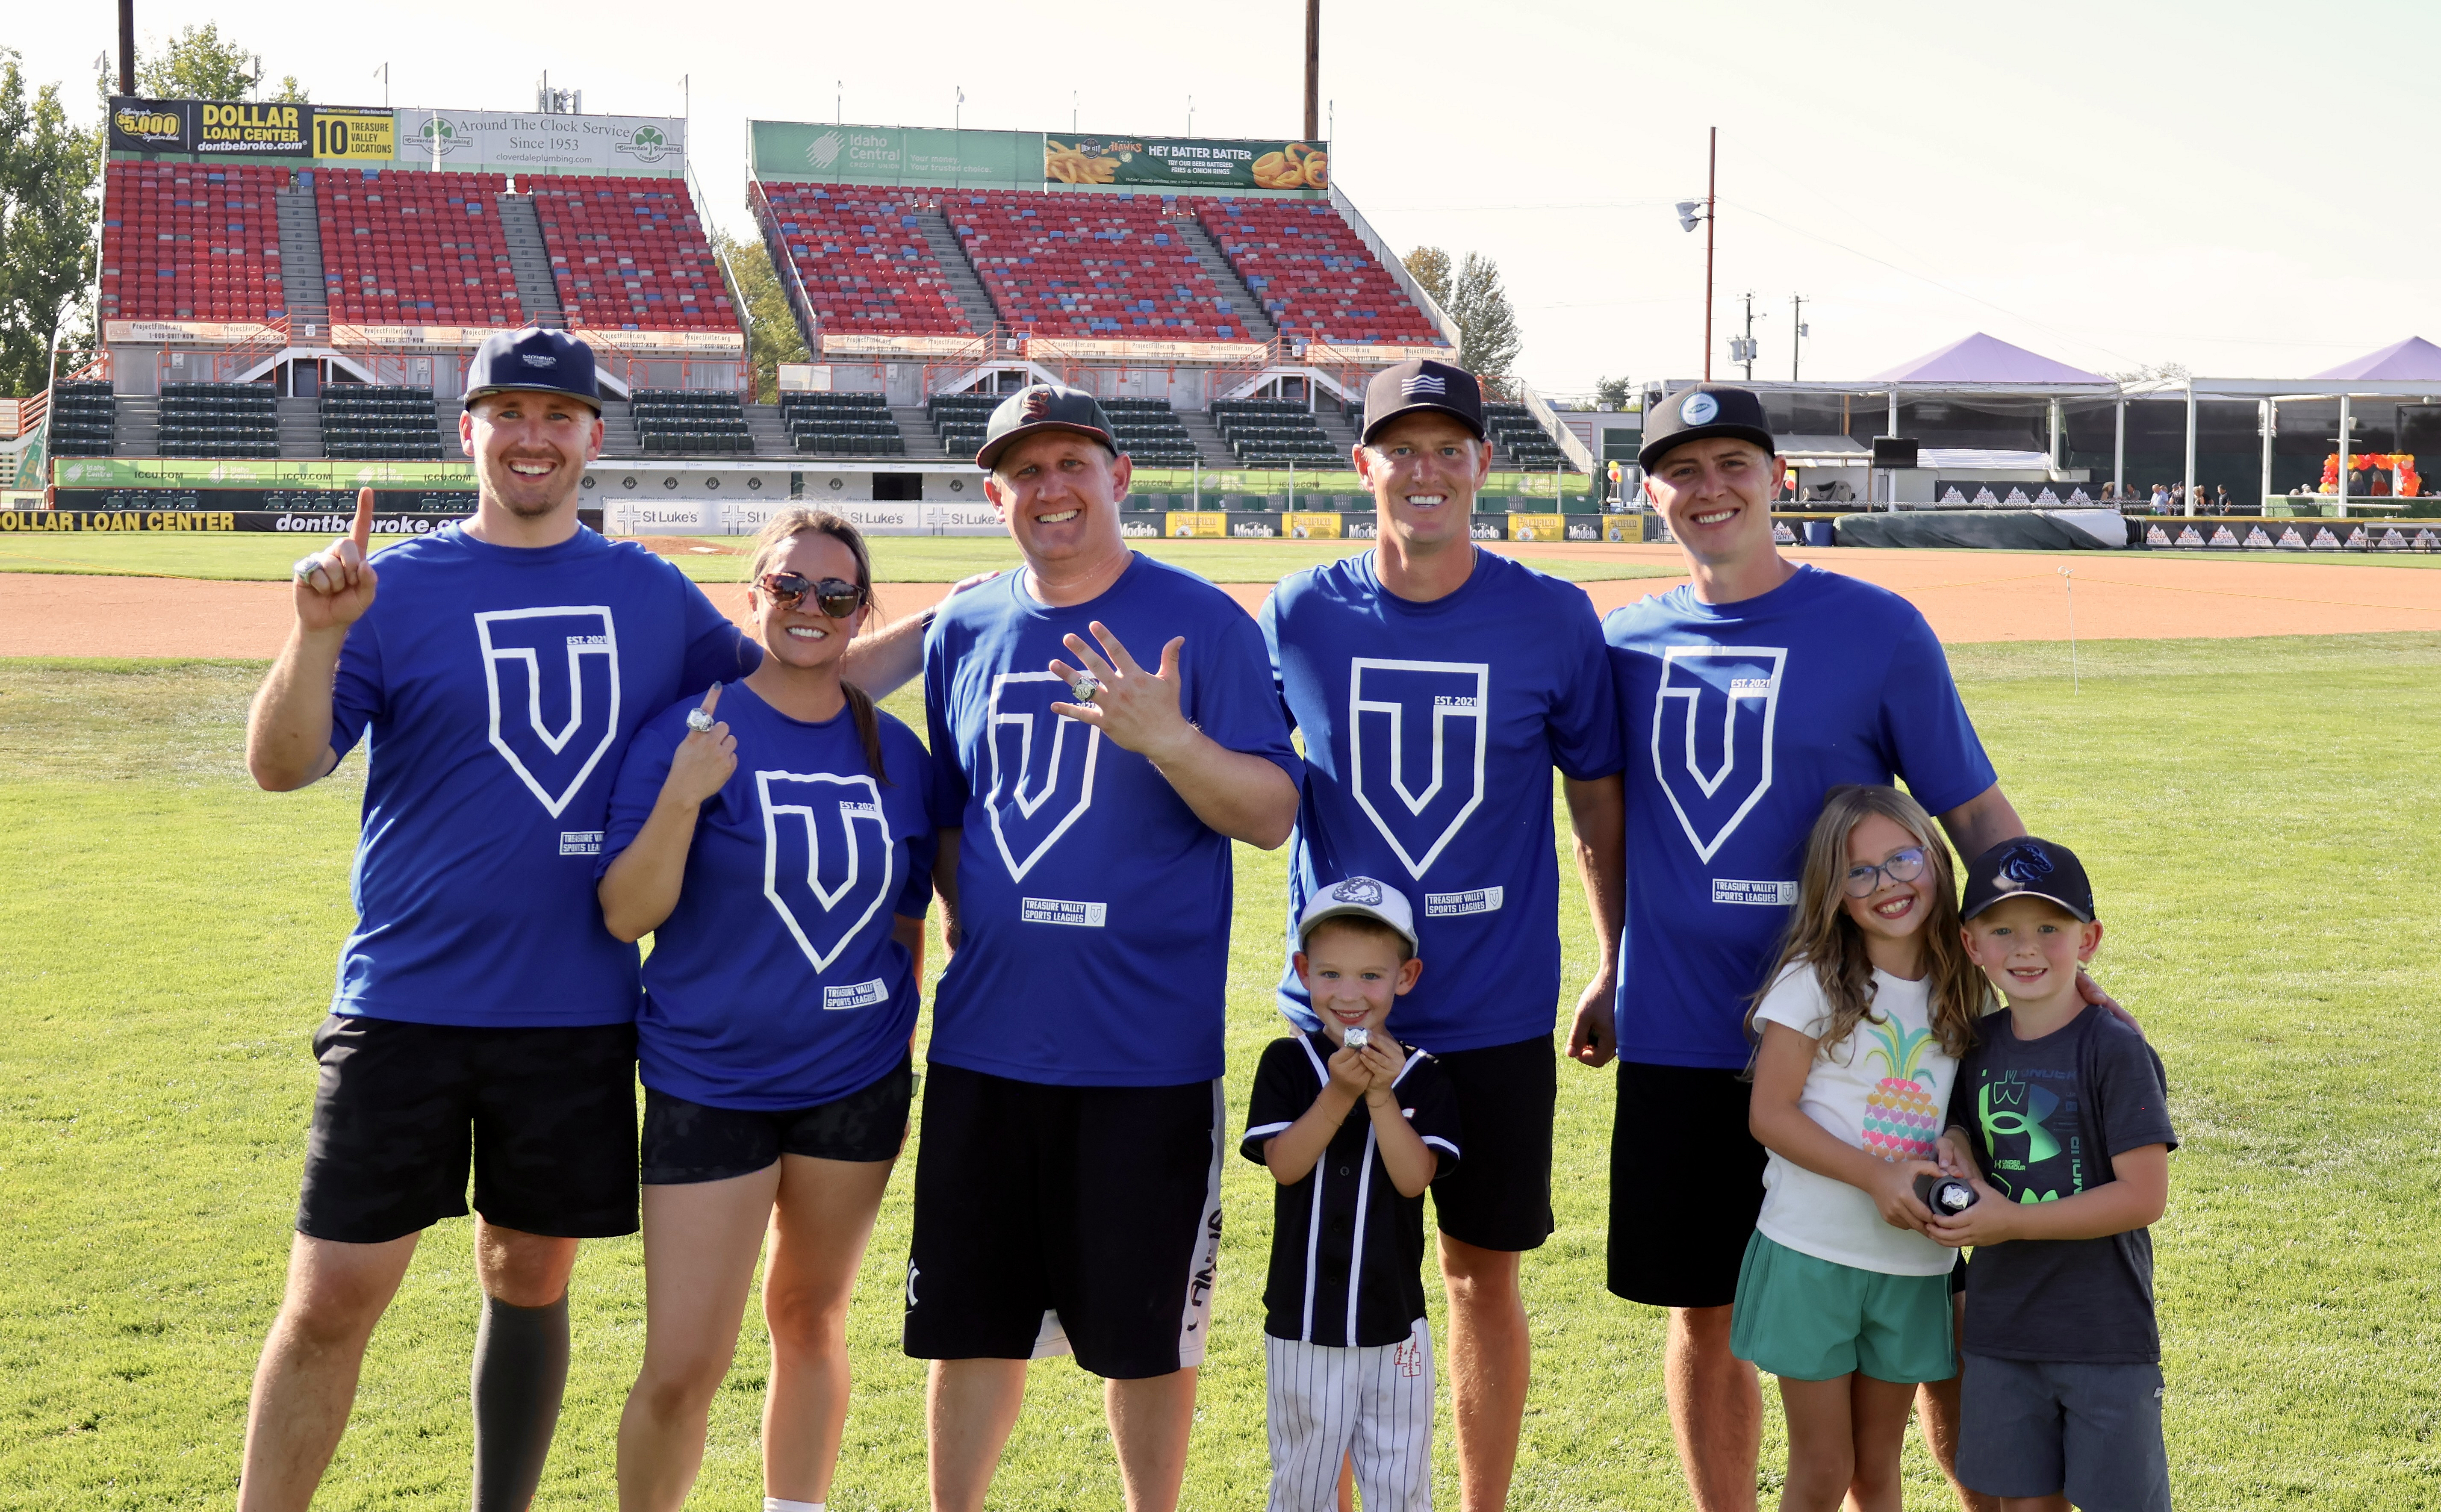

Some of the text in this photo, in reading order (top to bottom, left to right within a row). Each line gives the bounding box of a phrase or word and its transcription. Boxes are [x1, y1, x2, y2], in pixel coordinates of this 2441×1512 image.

[203, 104, 298, 128] DOLLAR
[118, 114, 177, 134] $5,000
[351, 122, 389, 132] TREASURE
[459, 118, 630, 138] Around The Clock Service
[203, 127, 299, 141] LOAN CENTER
[317, 120, 347, 154] 10
[351, 133, 377, 142] VALLEY
[510, 137, 578, 150] Since 1953
[850, 134, 887, 147] Idaho
[351, 144, 391, 153] LOCATIONS
[1108, 141, 1142, 153] HAWKS
[1149, 145, 1252, 160] HEY BATTER BATTER
[496, 153, 592, 164] cloverdaleplumbing.com
[850, 147, 900, 160] Central
[931, 156, 959, 164] money.
[931, 164, 961, 172] trusted
[135, 471, 183, 479] ICCU.COM
[0, 511, 234, 531] OLLAR LOAN CENTER
[643, 511, 698, 522] St Luke's
[748, 512, 760, 522] St
[850, 513, 903, 524] St Luke's
[952, 513, 964, 525] St
[1120, 523, 1157, 537] Modelo
[1234, 524, 1274, 537] Modelo
[1349, 525, 1377, 538] Mode
[1569, 525, 1596, 539] Modelo
[2147, 531, 2166, 539] Coors
[2179, 531, 2200, 539] Coors
[2212, 531, 2234, 539] Coors
[2280, 532, 2302, 540] Coors
[566, 635, 607, 644] EST. 2021
[1731, 678, 1771, 688] EST. 2021
[1434, 696, 1477, 706] EST. 2021
[840, 800, 876, 811] EST. 2021
[564, 834, 593, 843] TREASURE
[563, 843, 586, 852] SPORTS
[1716, 881, 1776, 893] TREASURE VALLEY
[1429, 892, 1484, 905] TREASURE VALLEY
[1716, 891, 1776, 902] SPORTS LEAGUES
[1026, 900, 1084, 913] TREASURE VALLEY
[1429, 901, 1485, 914] SPORTS LEAGUES
[1025, 910, 1084, 923] SPORTS LEAGUES
[828, 987, 855, 997] TREASURE
[827, 998, 851, 1007] SPORTS
